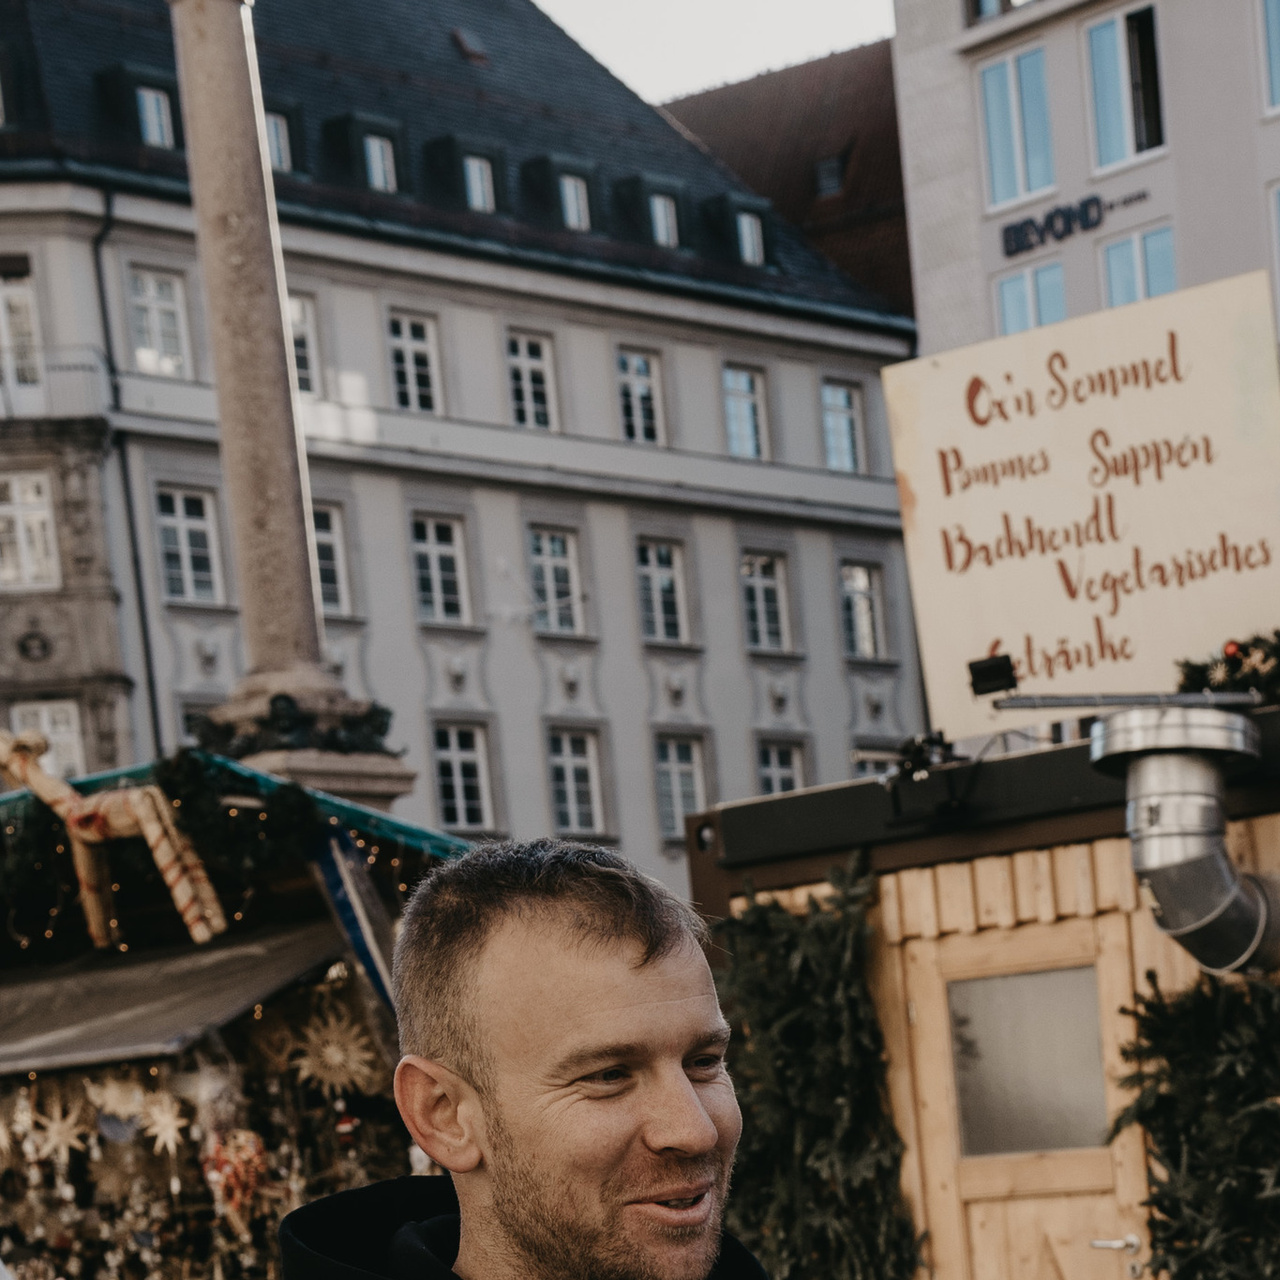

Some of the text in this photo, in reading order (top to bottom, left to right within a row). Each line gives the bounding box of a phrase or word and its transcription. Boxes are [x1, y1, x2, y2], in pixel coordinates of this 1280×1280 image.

[1046, 330, 1184, 411] Semmel
[937, 427, 1214, 497] Pommes Suppen
[1056, 532, 1274, 617] Vegetarisches
